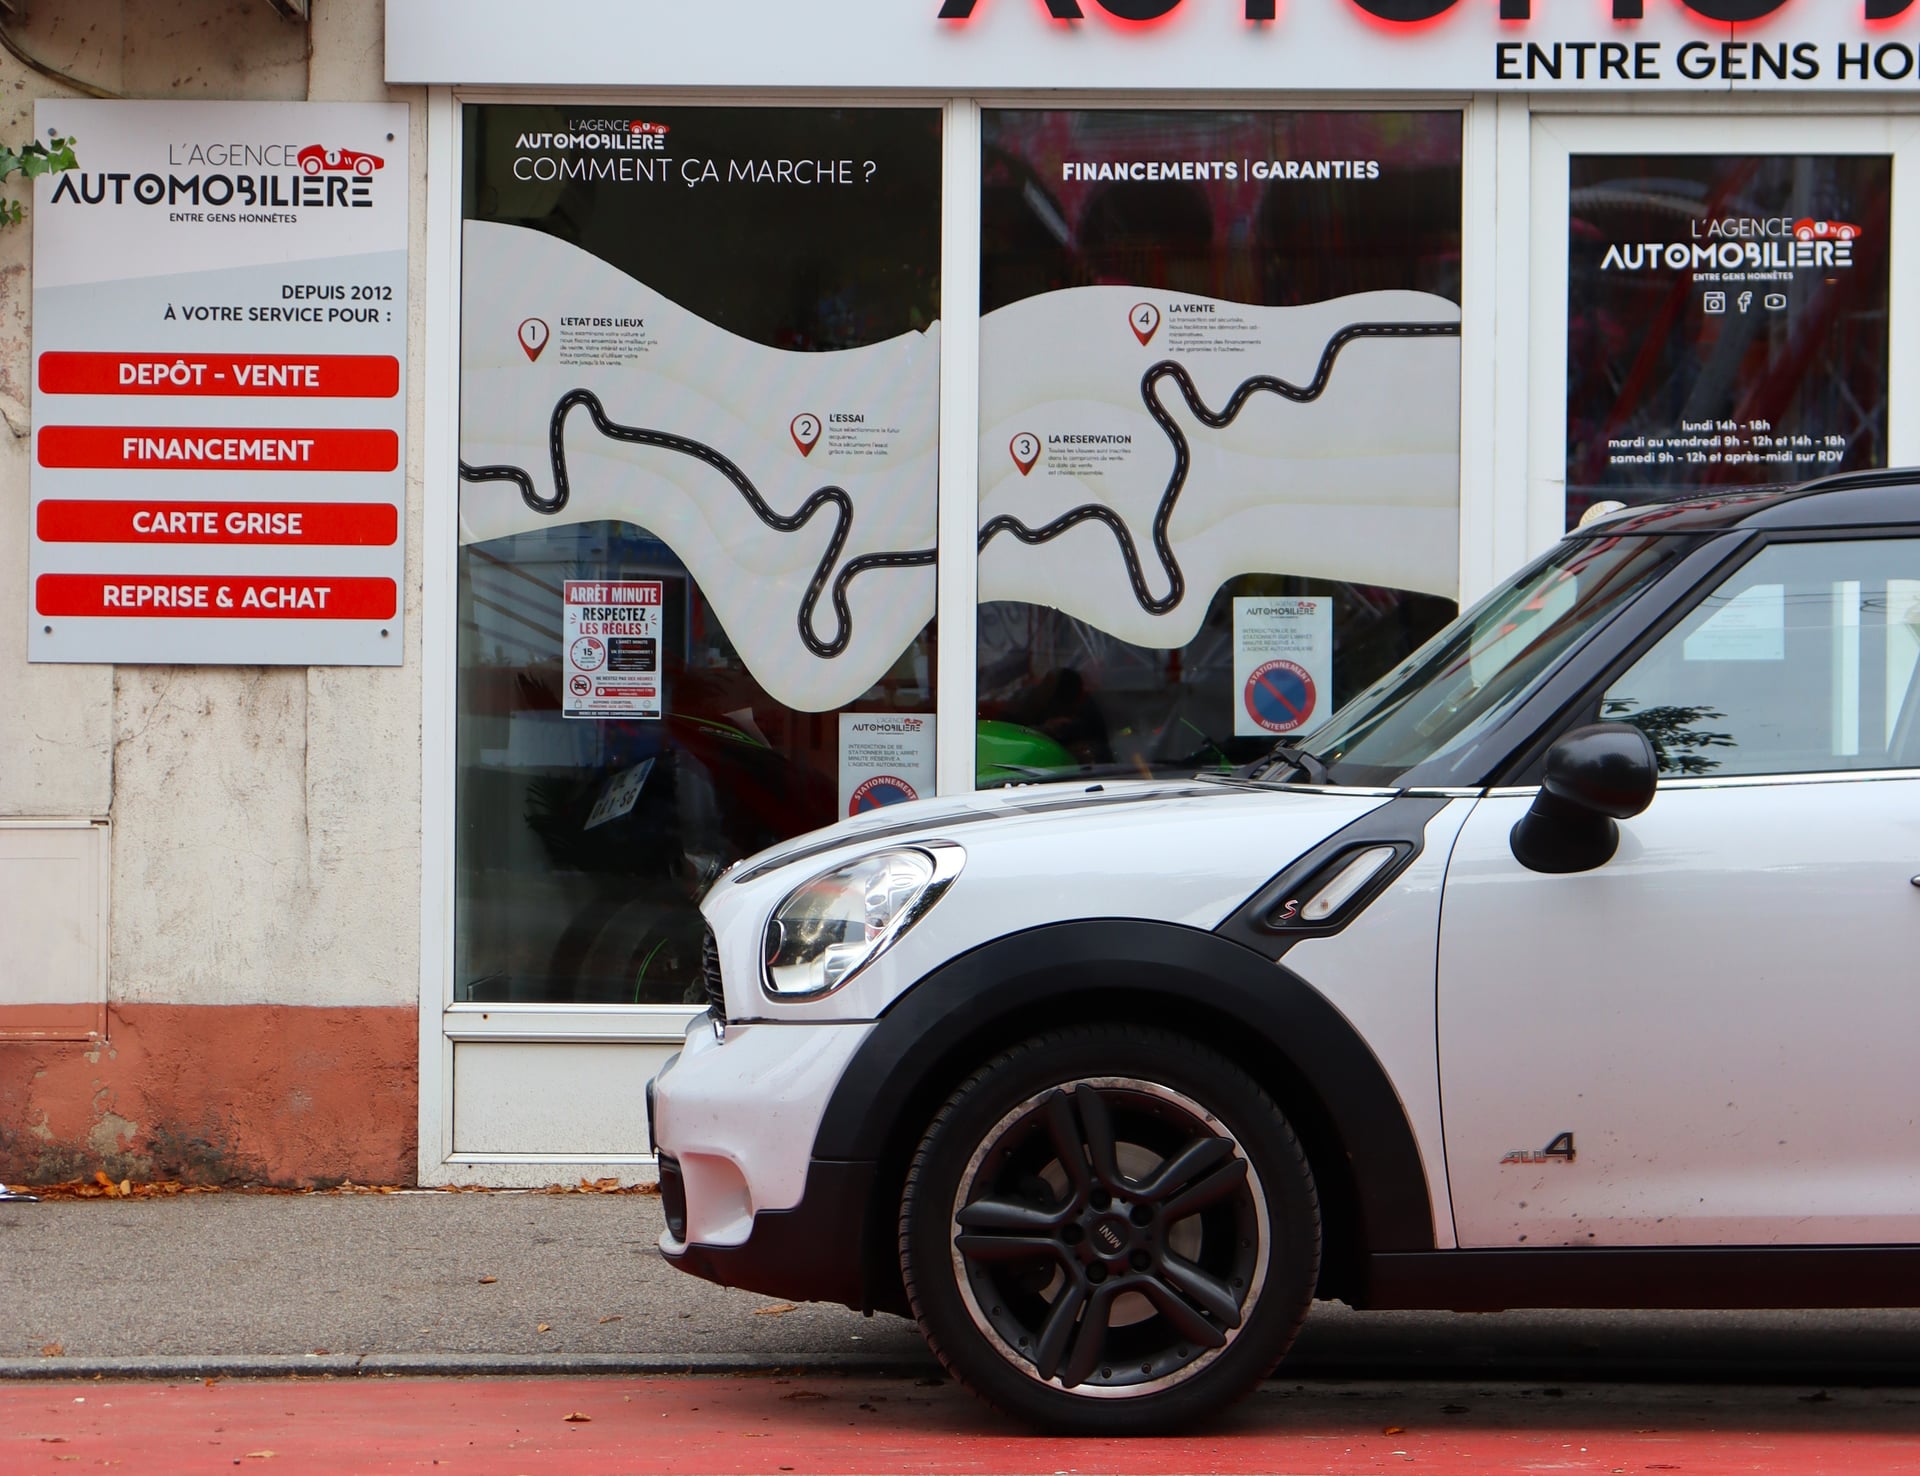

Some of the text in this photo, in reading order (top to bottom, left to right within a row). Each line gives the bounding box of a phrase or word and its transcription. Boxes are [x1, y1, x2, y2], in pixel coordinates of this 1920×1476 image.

[1496, 40, 1920, 80] ENTRE GENS HO
[569, 119, 630, 132] L'AGENCE
[169, 143, 297, 167] L'AGENCE
[513, 157, 877, 188] COMMENT ÇA MARCHE ?
[1062, 160, 1379, 181] FINANCEMENTS GARANTIES
[169, 211, 297, 224] ENTRE GENS HONNÊTES
[1691, 217, 1793, 238] L'AGENCE
[1692, 270, 1794, 282] ENTRE GENS HONNÊTES
[282, 285, 393, 300] DEPUIS 2012
[164, 302, 177, 321] À
[181, 306, 243, 321] VOTRE
[248, 307, 323, 322] SERVICE
[328, 308, 380, 323] POUR
[1169, 304, 1216, 313] LA VENTE
[560, 317, 644, 328] L'ETAT DES LIEUX
[1139, 311, 1151, 325] 4
[529, 325, 536, 341] 1
[118, 360, 207, 385] DEPÔT
[232, 364, 320, 388] VENTE
[829, 414, 864, 422] L'ESSAI
[1682, 420, 1713, 432] lundi
[1716, 420, 1737, 431] 14h
[1749, 420, 1771, 431] 18h
[801, 420, 812, 436] 2
[1020, 439, 1031, 455] 3
[1048, 434, 1132, 444] LA RESERVATION
[1608, 436, 1645, 448] mardi
[1647, 439, 1664, 448] au
[1666, 436, 1722, 447] vendredi
[1724, 436, 1740, 447] 9h
[1753, 435, 1773, 447] 12h
[1775, 437, 1788, 446] et
[1790, 436, 1812, 446] 14h
[1824, 436, 1846, 446] 18h
[123, 437, 314, 461] FINANCEMENT
[1610, 452, 1655, 464] samedi
[1658, 452, 1674, 463] 9h
[1686, 452, 1706, 463] 12h
[1709, 452, 1722, 463] et
[1724, 451, 1794, 466] après-midi
[1796, 453, 1814, 462] sur
[1817, 451, 1844, 462] RDV
[132, 511, 302, 535] CARTE GRISE
[103, 585, 330, 609] REPRISE & ACHAT
[570, 584, 657, 603] ARRÊT MINUTE
[582, 607, 646, 621] RESPECTEZ
[580, 623, 599, 635] LES
[582, 648, 593, 656] 15
[1250, 661, 1310, 685] STATIONNEMENT
[1260, 719, 1300, 731] INTERDIT
[854, 777, 917, 801] STATIONNEMENT
[1279, 899, 1299, 920] S
[1499, 1129, 1577, 1165] ALL4
[1098, 1224, 1122, 1249] MINI
